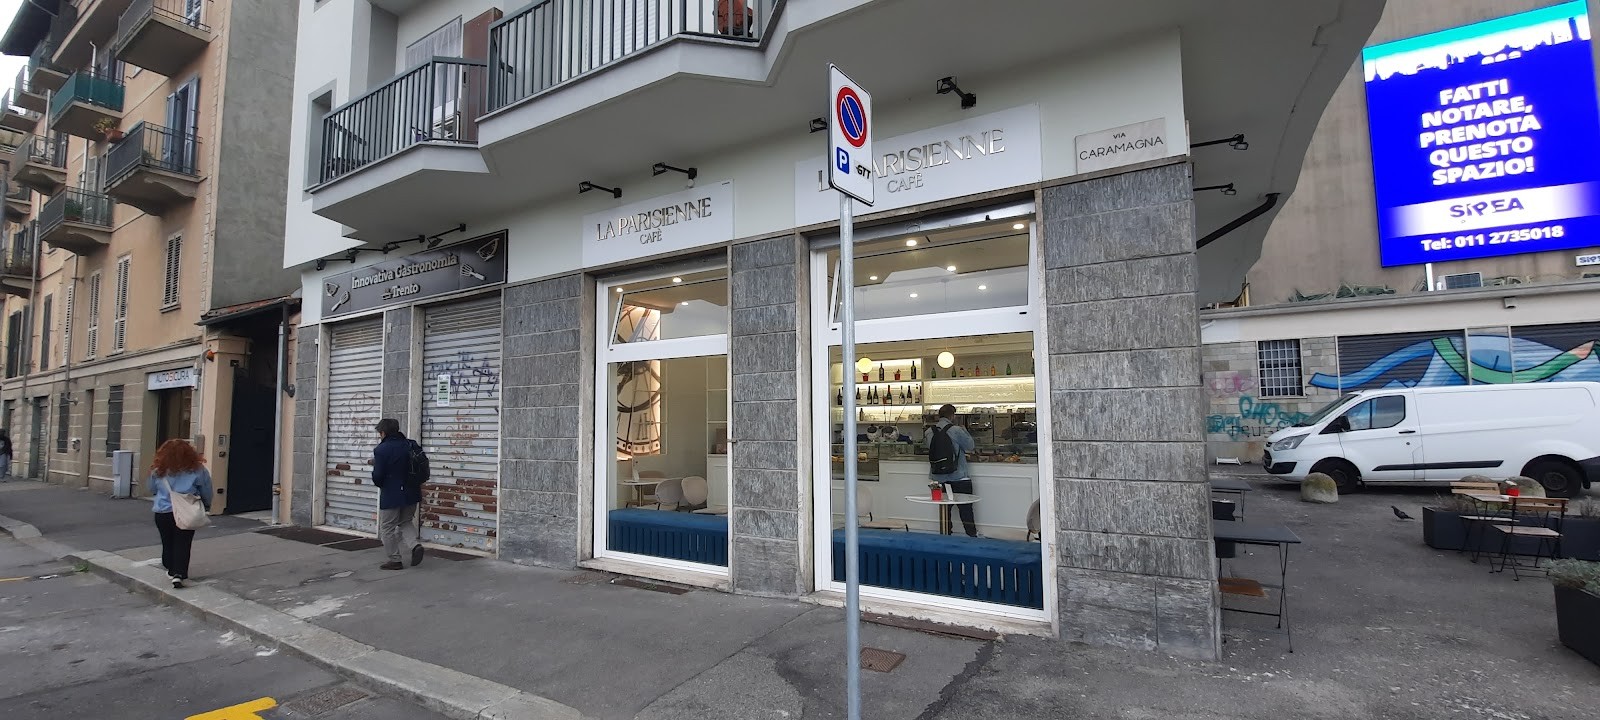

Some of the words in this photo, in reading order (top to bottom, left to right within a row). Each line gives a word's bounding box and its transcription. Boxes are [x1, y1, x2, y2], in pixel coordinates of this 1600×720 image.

[1439, 78, 1509, 106] FATTI
[1421, 96, 1533, 128] NOTARE,
[1113, 132, 1126, 140] VIA
[1419, 114, 1542, 149] PRENOTA
[872, 128, 1006, 179] ARISIENNE
[1079, 136, 1164, 161] CARAMAGNA
[1429, 136, 1534, 168] QUESTO
[887, 170, 924, 194] CAFÈ
[1432, 156, 1535, 186] SPAZIO!
[596, 221, 616, 241] LA
[618, 197, 712, 236] PARISIENNE
[639, 228, 663, 245] CAFÈ
[1421, 238, 1452, 252] Tel:
[1454, 233, 1485, 248] 011
[1488, 225, 1565, 245] 2735018
[351, 269, 394, 290] Innovativa
[395, 252, 459, 279] Gastronomia
[391, 283, 420, 299] Trento
